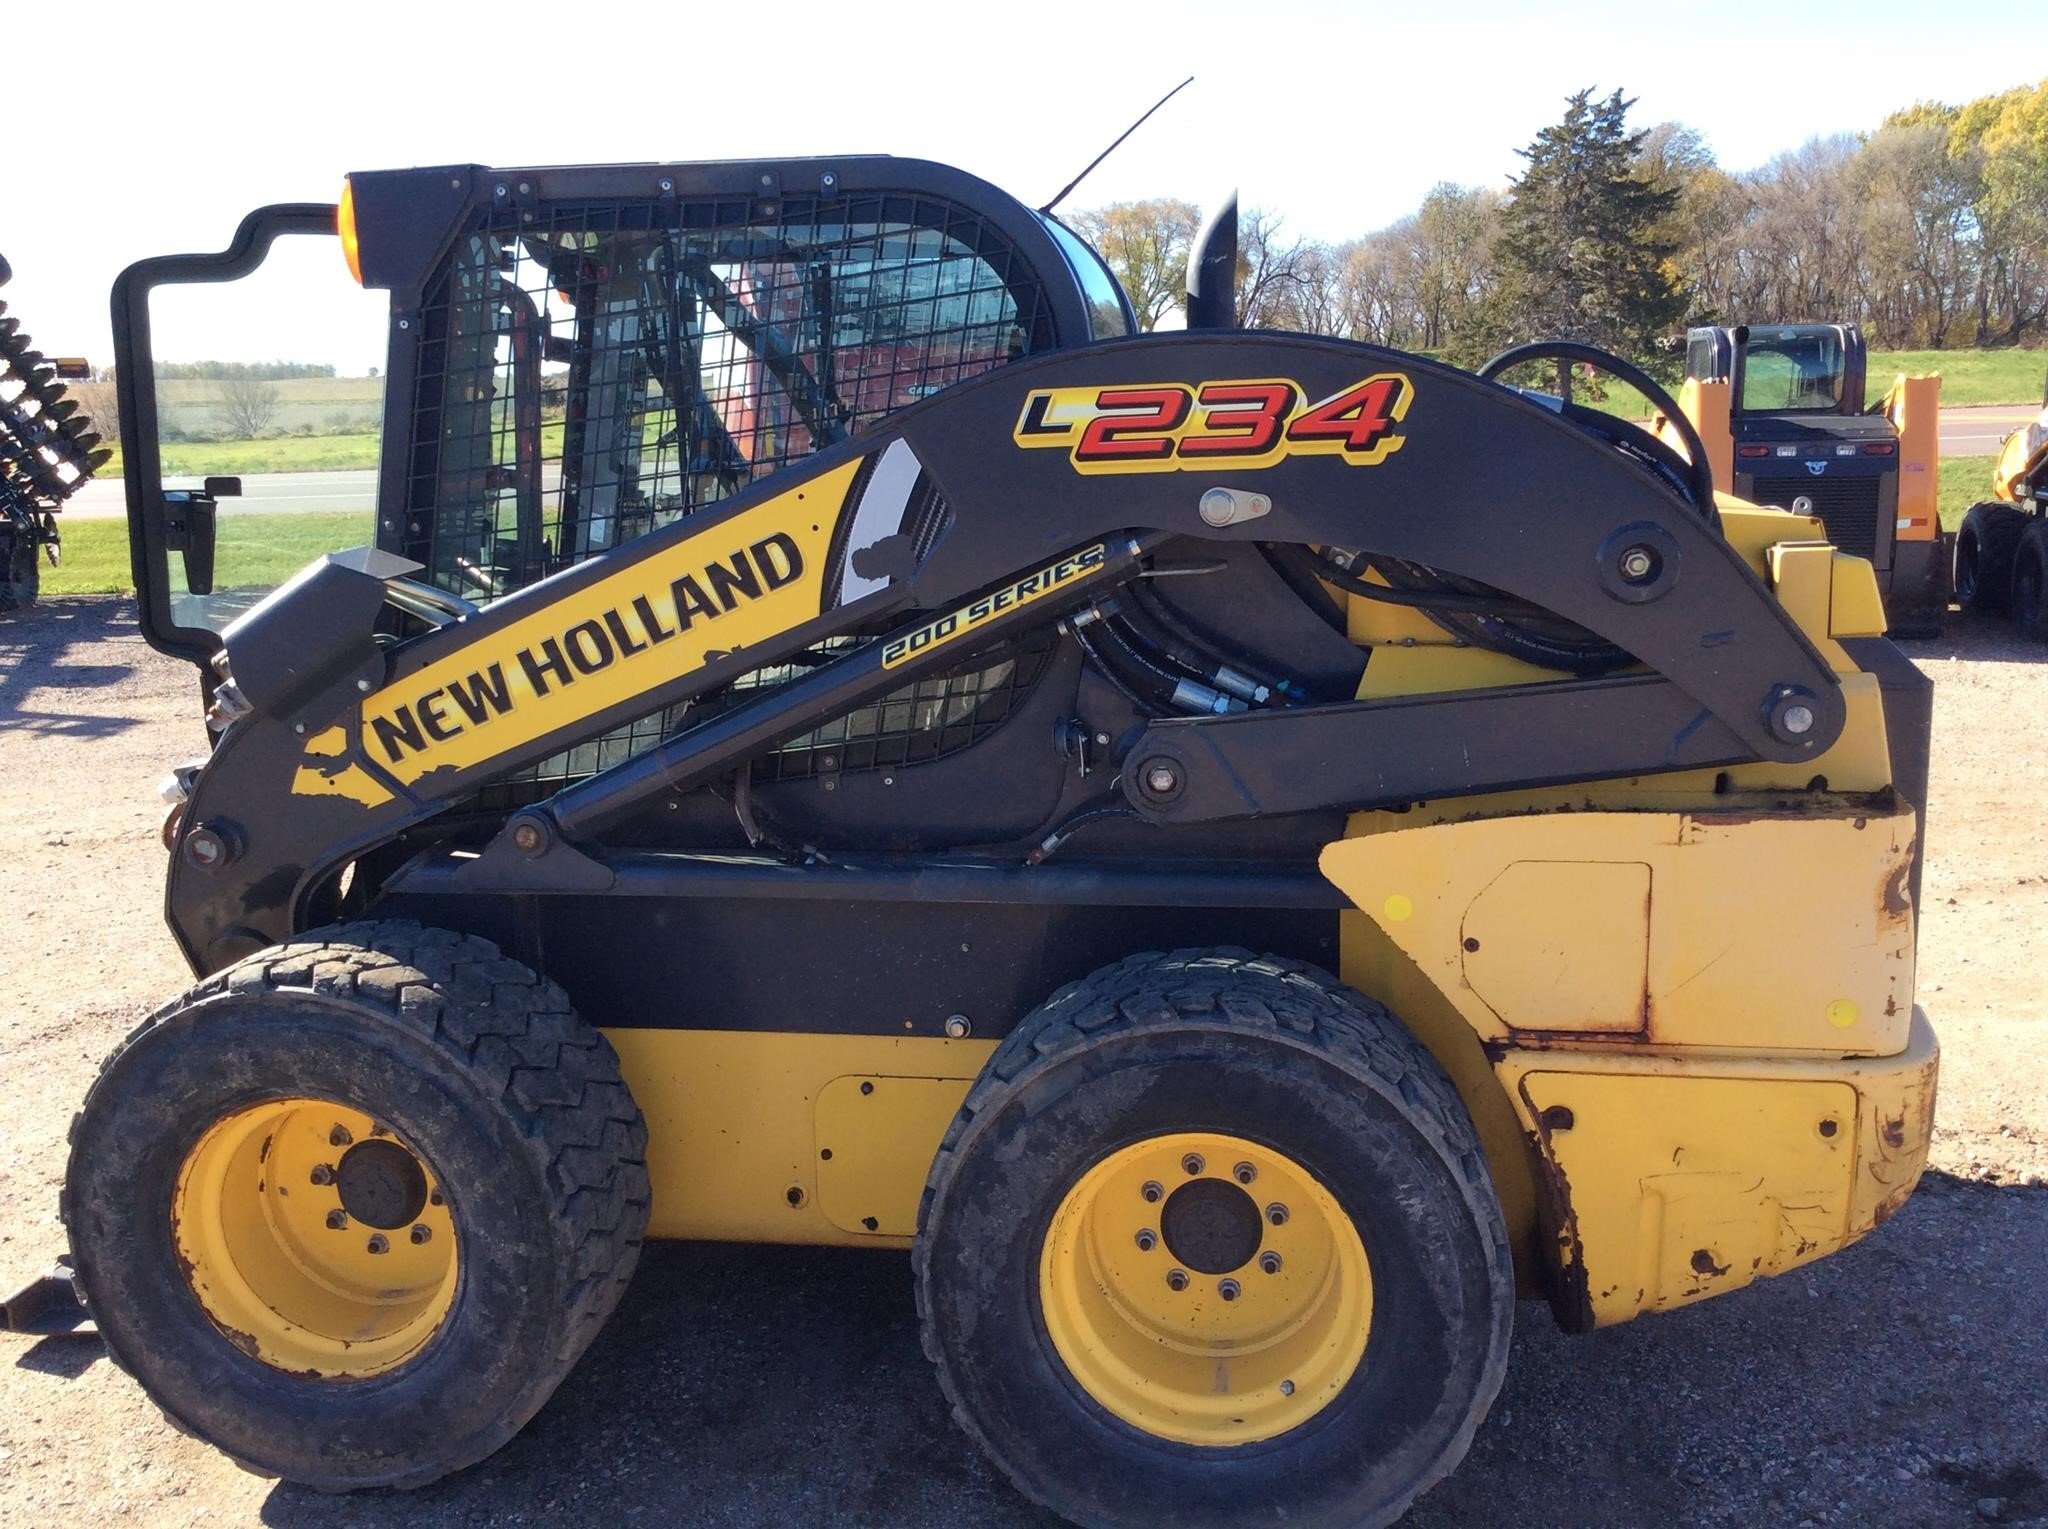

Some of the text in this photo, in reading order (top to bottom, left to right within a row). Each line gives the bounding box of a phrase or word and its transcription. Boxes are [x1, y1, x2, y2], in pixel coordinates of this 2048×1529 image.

[1018, 378, 1401, 463] L234
[372, 532, 805, 763] NEW HOLLAND
[886, 549, 1102, 665] 200 SERIES
